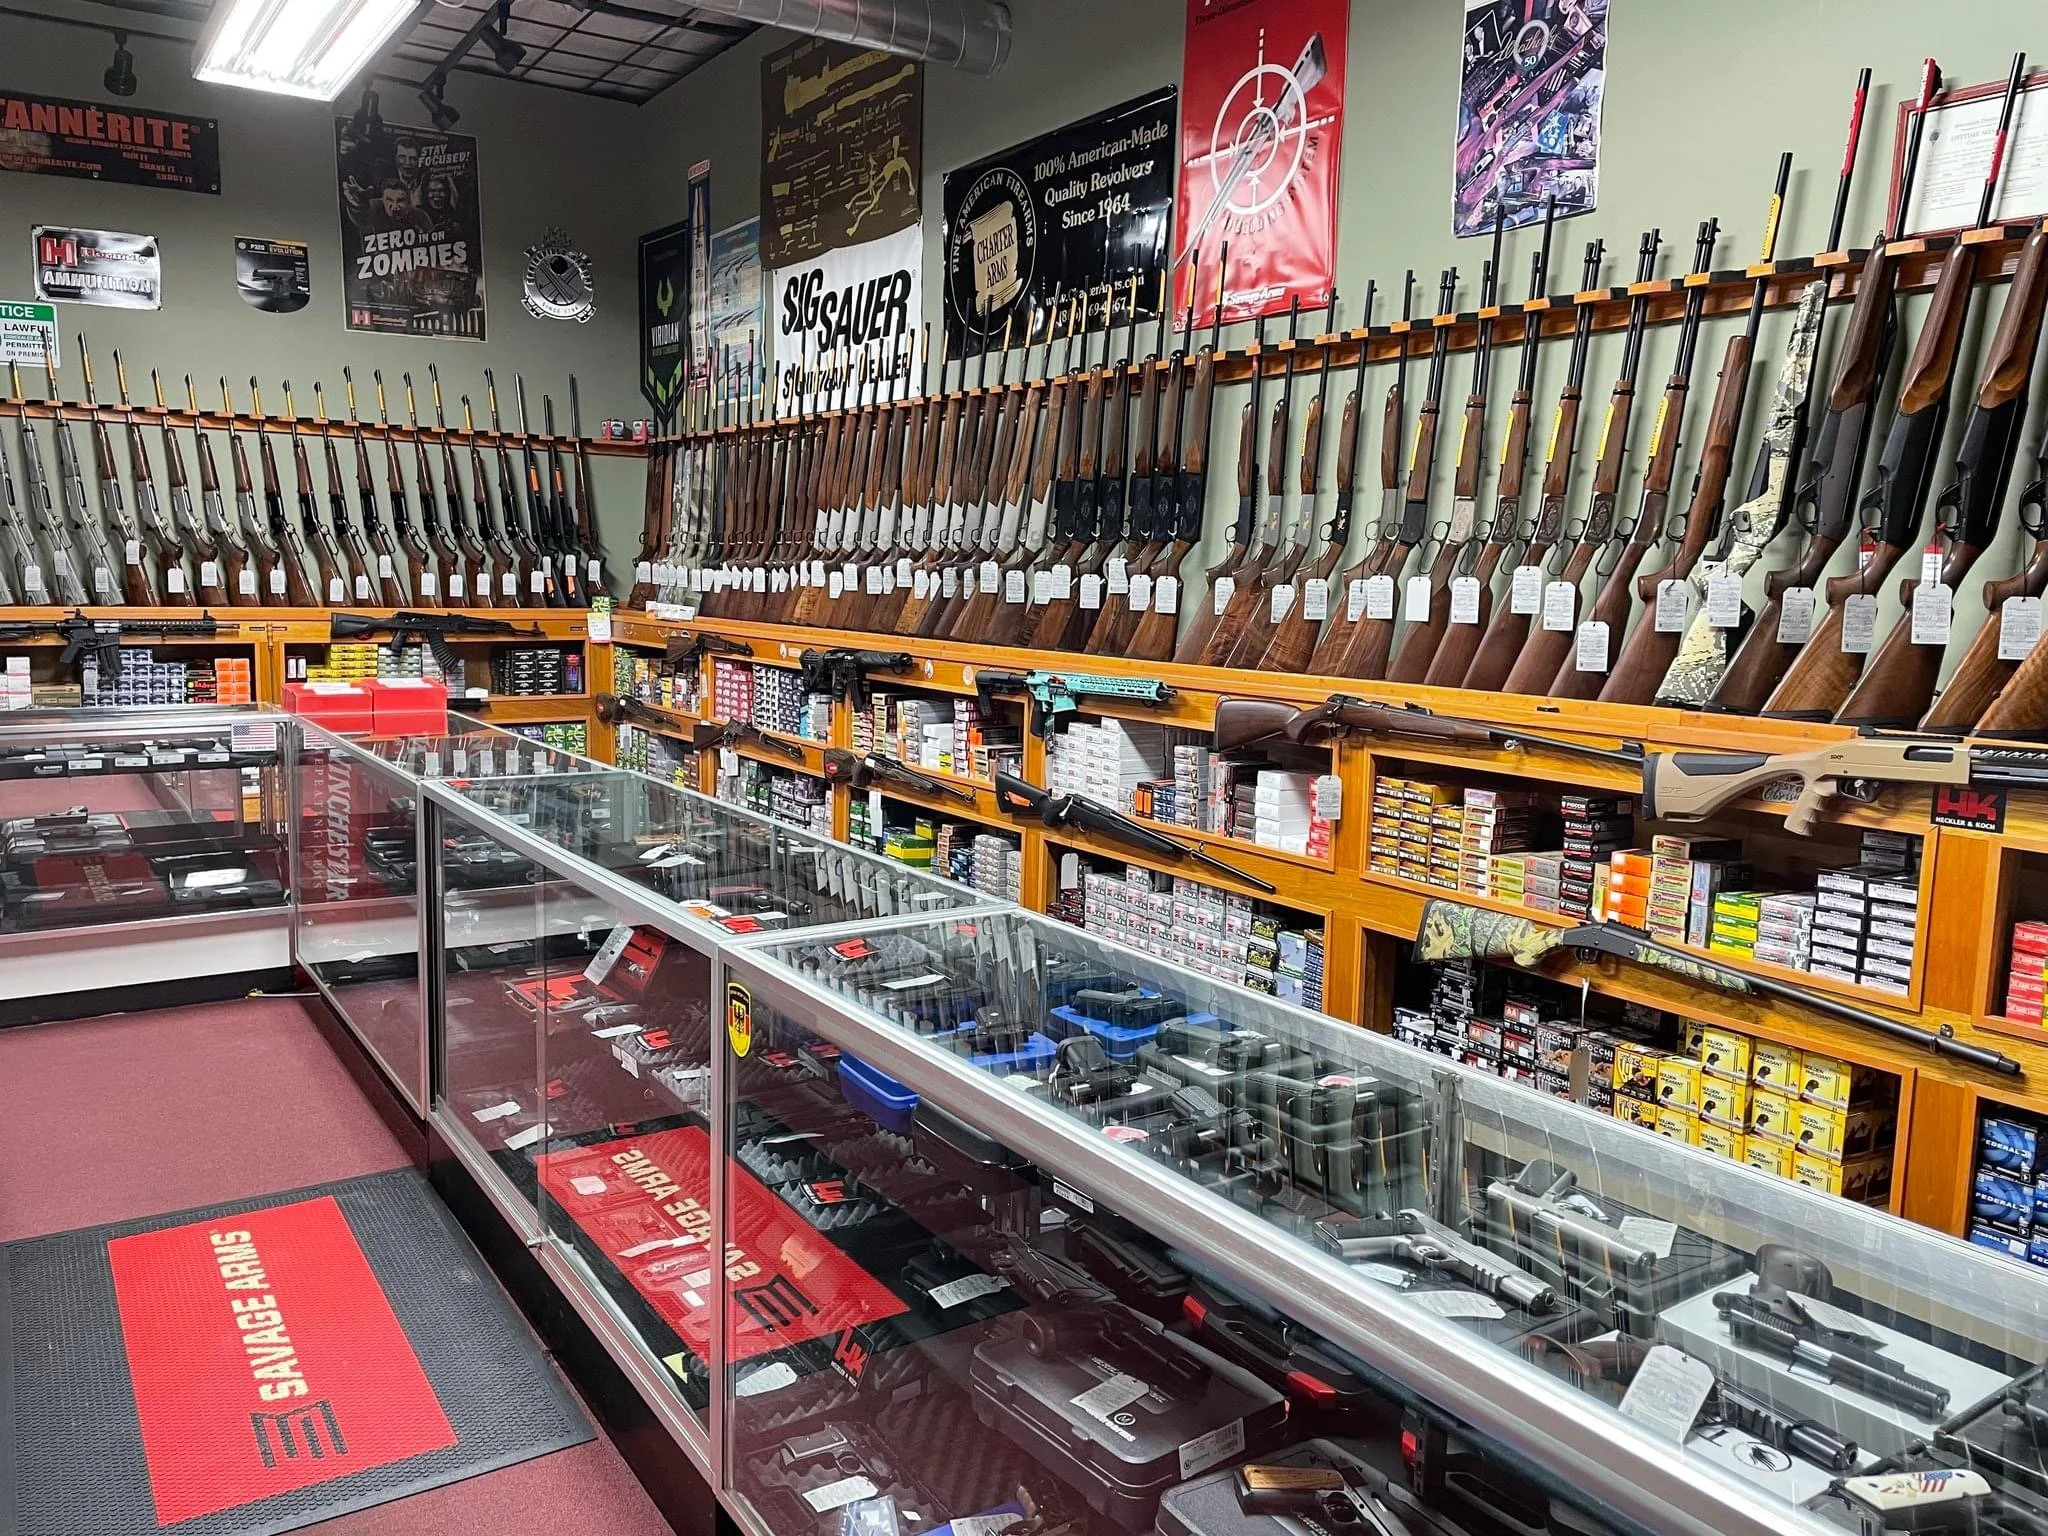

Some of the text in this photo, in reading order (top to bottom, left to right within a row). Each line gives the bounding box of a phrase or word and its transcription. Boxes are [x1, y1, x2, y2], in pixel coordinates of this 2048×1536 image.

[1524, 55, 1537, 67] 50
[0, 97, 191, 150] ANNERITE
[418, 152, 470, 167] FOCUSED!
[422, 144, 448, 156] STAY
[1034, 120, 1168, 182] 100% American-Made
[1045, 160, 1154, 207] Quality Revolvers
[953, 172, 1034, 273] FINE AMERICAN FIREARMS
[1062, 192, 1130, 229] Since 1964
[364, 229, 445, 253] ZERO IN ON
[977, 223, 1014, 264] CHARTER
[357, 241, 467, 280] ZOMBIES
[986, 255, 1008, 288] ARMS
[43, 270, 153, 293] AMMUNITION
[782, 268, 911, 353] SIG SAUER
[4, 323, 52, 334] LAWFUL
[651, 322, 679, 347] VIRIDIAN
[313, 757, 324, 839] EPEATING
[1937, 785, 1998, 821] HK
[326, 750, 351, 900] INCHESTER
[1935, 816, 1965, 827] HECKLER
[1976, 822, 1995, 831] KOCH
[1539, 1030, 1571, 1046] FIOCCHI
[1539, 1072, 1570, 1088] FIOCCHI
[1975, 1191, 2018, 1210] FEDERAL
[1972, 1229, 2001, 1242] FEDERAL
[210, 1230, 309, 1401] SAVAGE ARMS
[835, 1326, 868, 1379] HK
